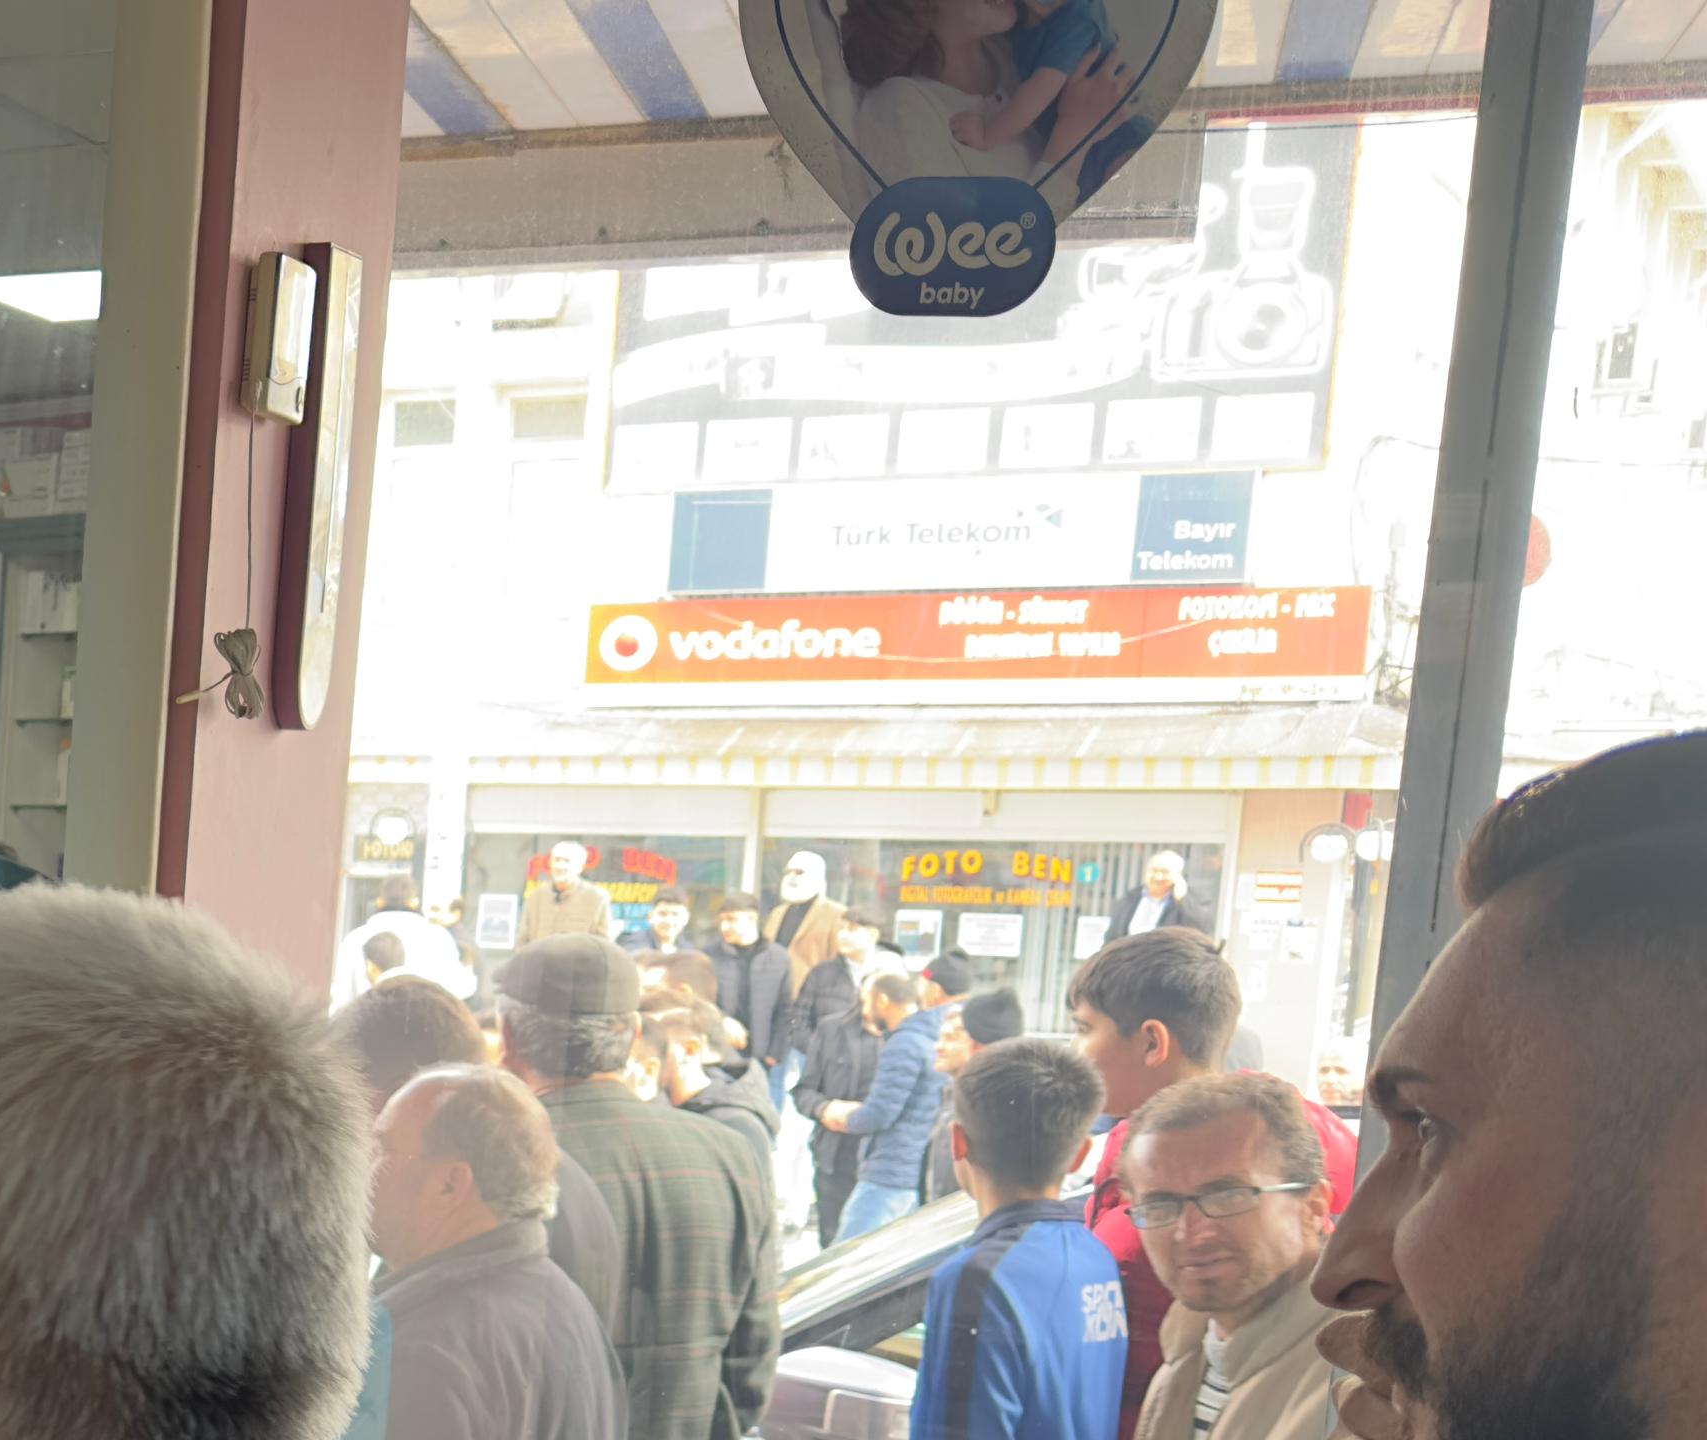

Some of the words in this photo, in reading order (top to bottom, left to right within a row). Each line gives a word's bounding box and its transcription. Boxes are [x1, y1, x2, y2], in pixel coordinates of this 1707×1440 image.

[919, 281, 985, 309] baby
[906, 522, 1031, 546] Telekom
[1174, 519, 1236, 543] Bayır
[1138, 550, 1234, 571] Telekom
[669, 619, 881, 661] vodafone
[901, 849, 984, 882] FOTO
[1012, 849, 1074, 885] BEN
